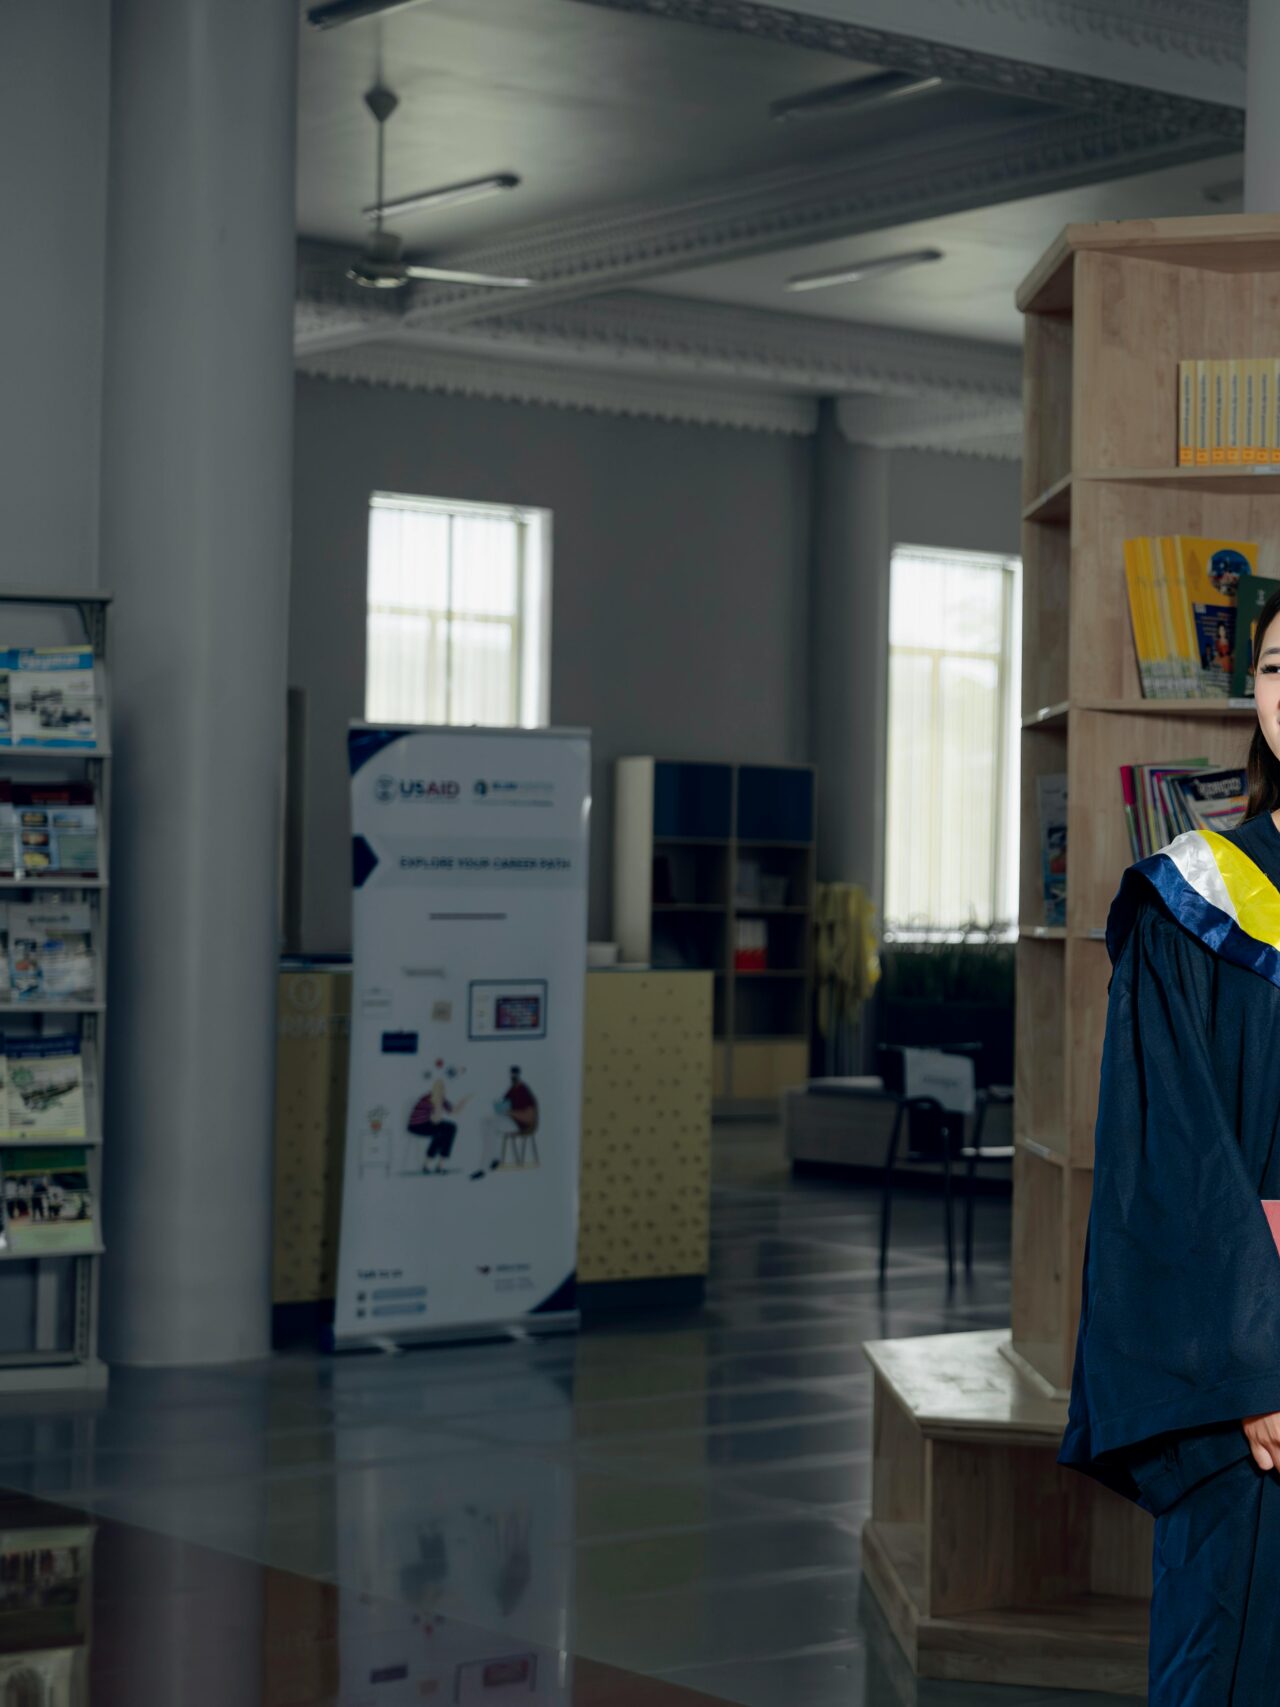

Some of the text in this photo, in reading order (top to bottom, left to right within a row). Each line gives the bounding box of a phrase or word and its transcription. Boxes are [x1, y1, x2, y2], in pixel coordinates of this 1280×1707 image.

[400, 779, 460, 798] USAID
[399, 856, 571, 871] EXPLORE YOUR CAREER PATH
